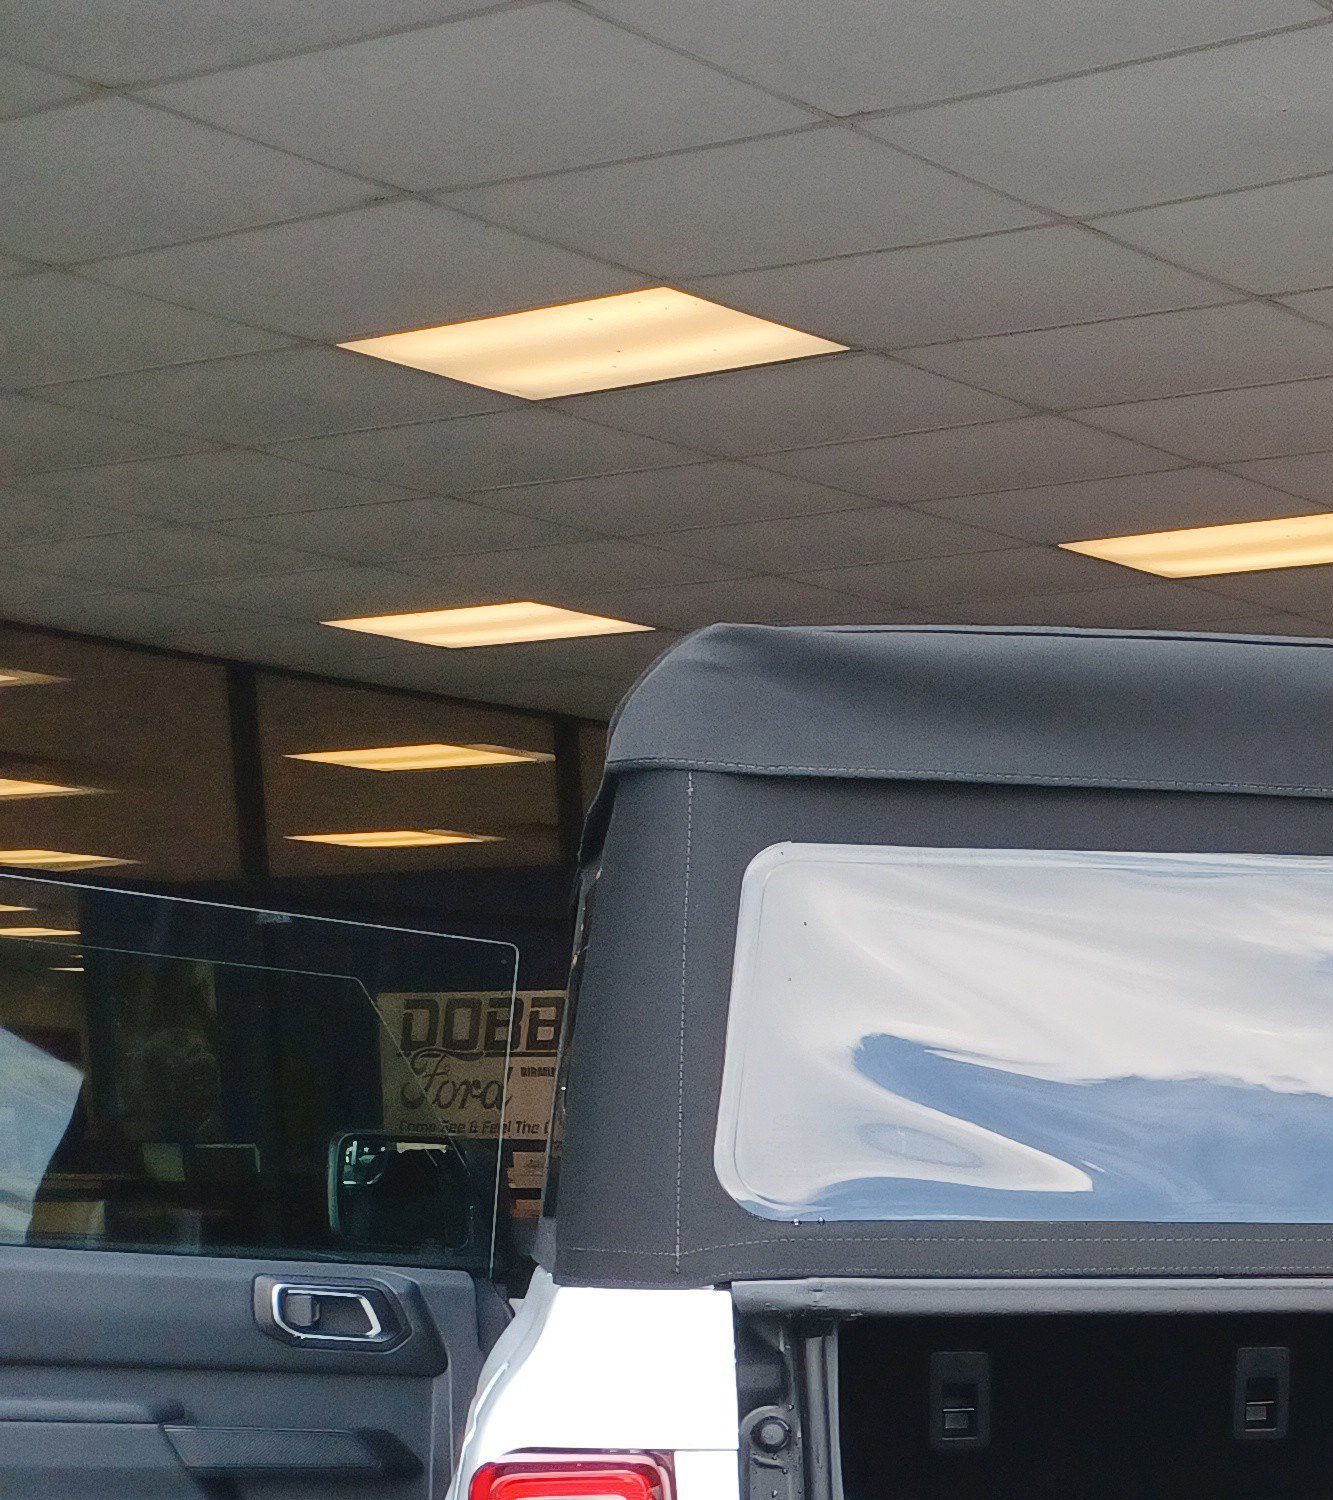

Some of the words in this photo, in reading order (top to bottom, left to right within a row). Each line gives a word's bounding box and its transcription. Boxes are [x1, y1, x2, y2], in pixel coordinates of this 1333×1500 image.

[401, 997, 567, 1051] DOBB
[400, 1047, 514, 1110] Ford
[516, 1120, 543, 1134] The
